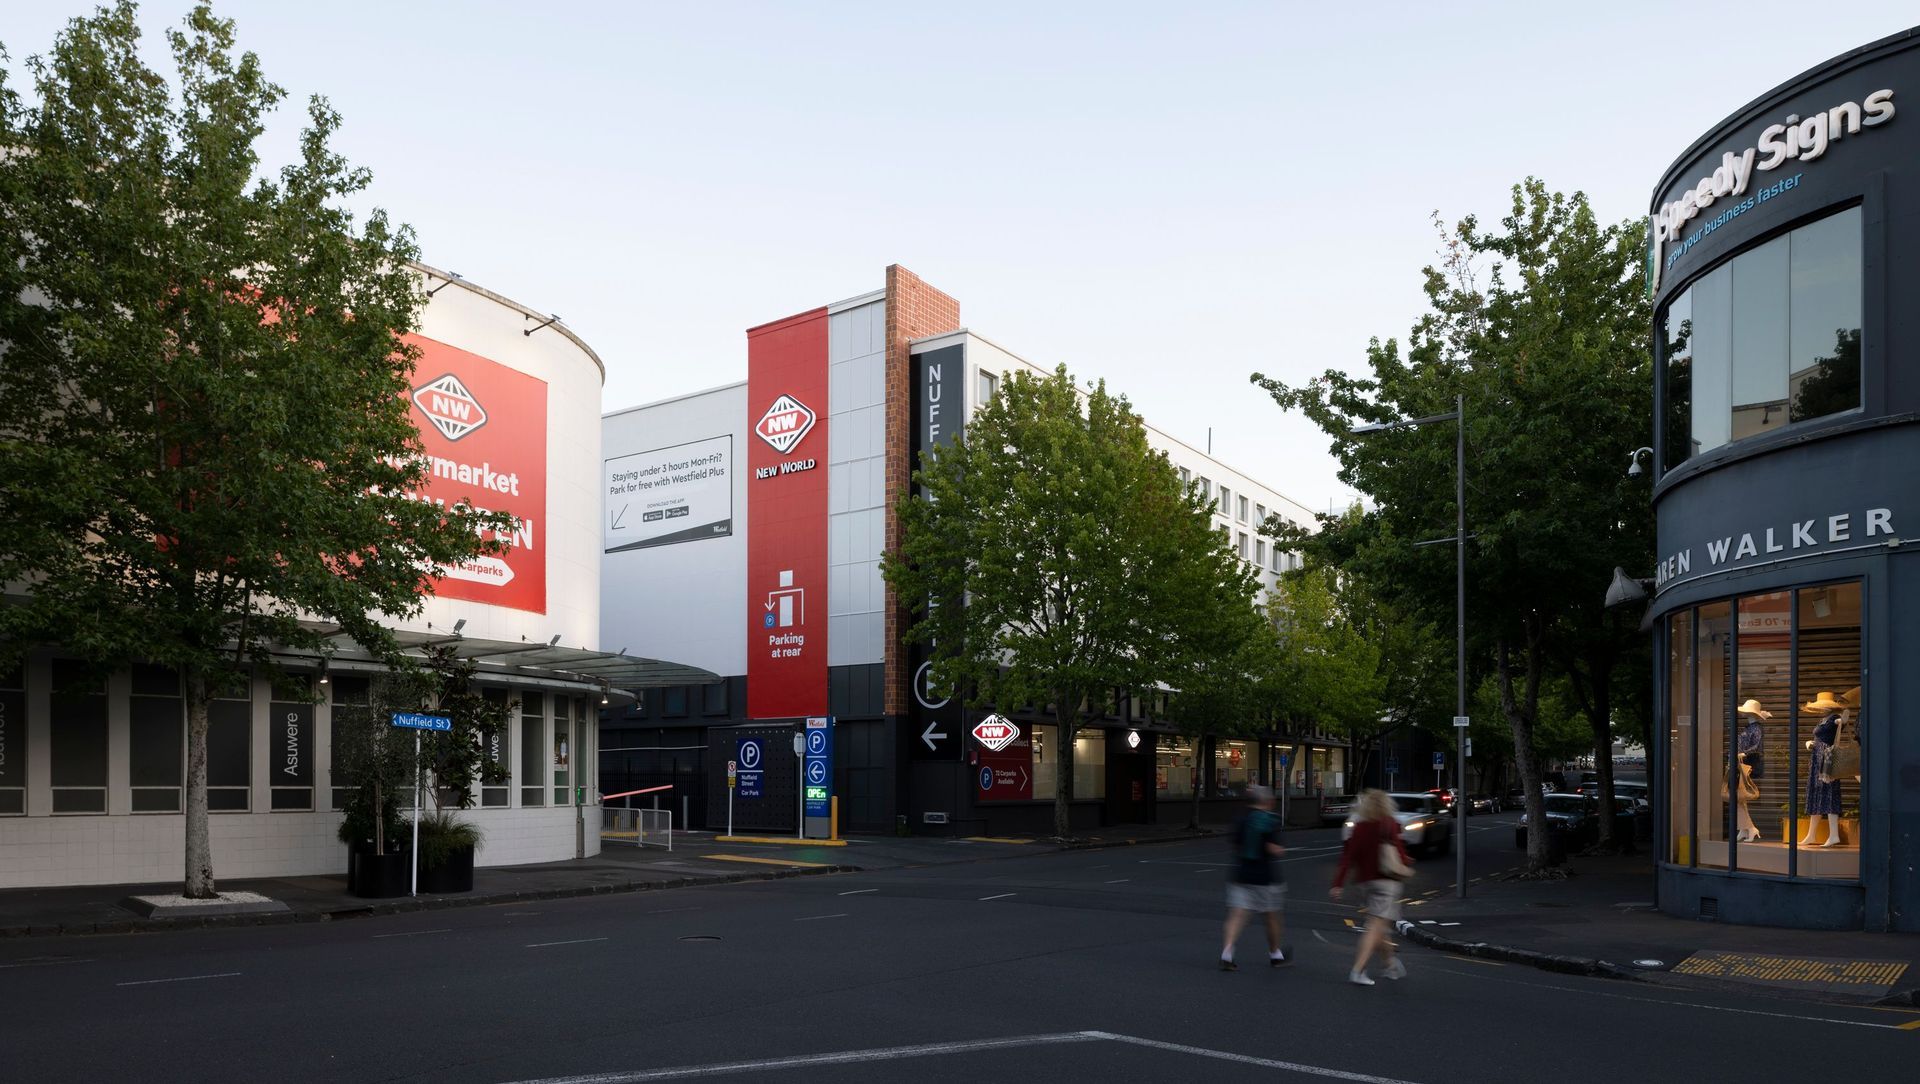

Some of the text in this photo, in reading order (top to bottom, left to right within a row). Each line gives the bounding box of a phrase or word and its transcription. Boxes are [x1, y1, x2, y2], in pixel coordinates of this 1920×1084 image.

[1659, 89, 1896, 242] Speedy Signs
[1683, 229, 1704, 255] your
[1704, 198, 1755, 236] business
[1757, 173, 1803, 204] faster
[432, 393, 471, 421] NW
[767, 412, 799, 434] NW
[612, 453, 722, 483] Staying under 3 hours Mon-Fri?
[756, 458, 816, 479] NEW WORLD
[610, 466, 725, 495] Park for free with Westfield Plus
[1655, 508, 1895, 589] AREN WALKER
[462, 558, 504, 577] Carparks
[769, 632, 804, 646] Parking
[771, 648, 802, 658] at rear
[398, 715, 445, 728] Nuffield St
[981, 726, 1005, 738] NW
[283, 712, 299, 777] Asuwere
[812, 735, 821, 749] P
[746, 746, 756, 763] P
